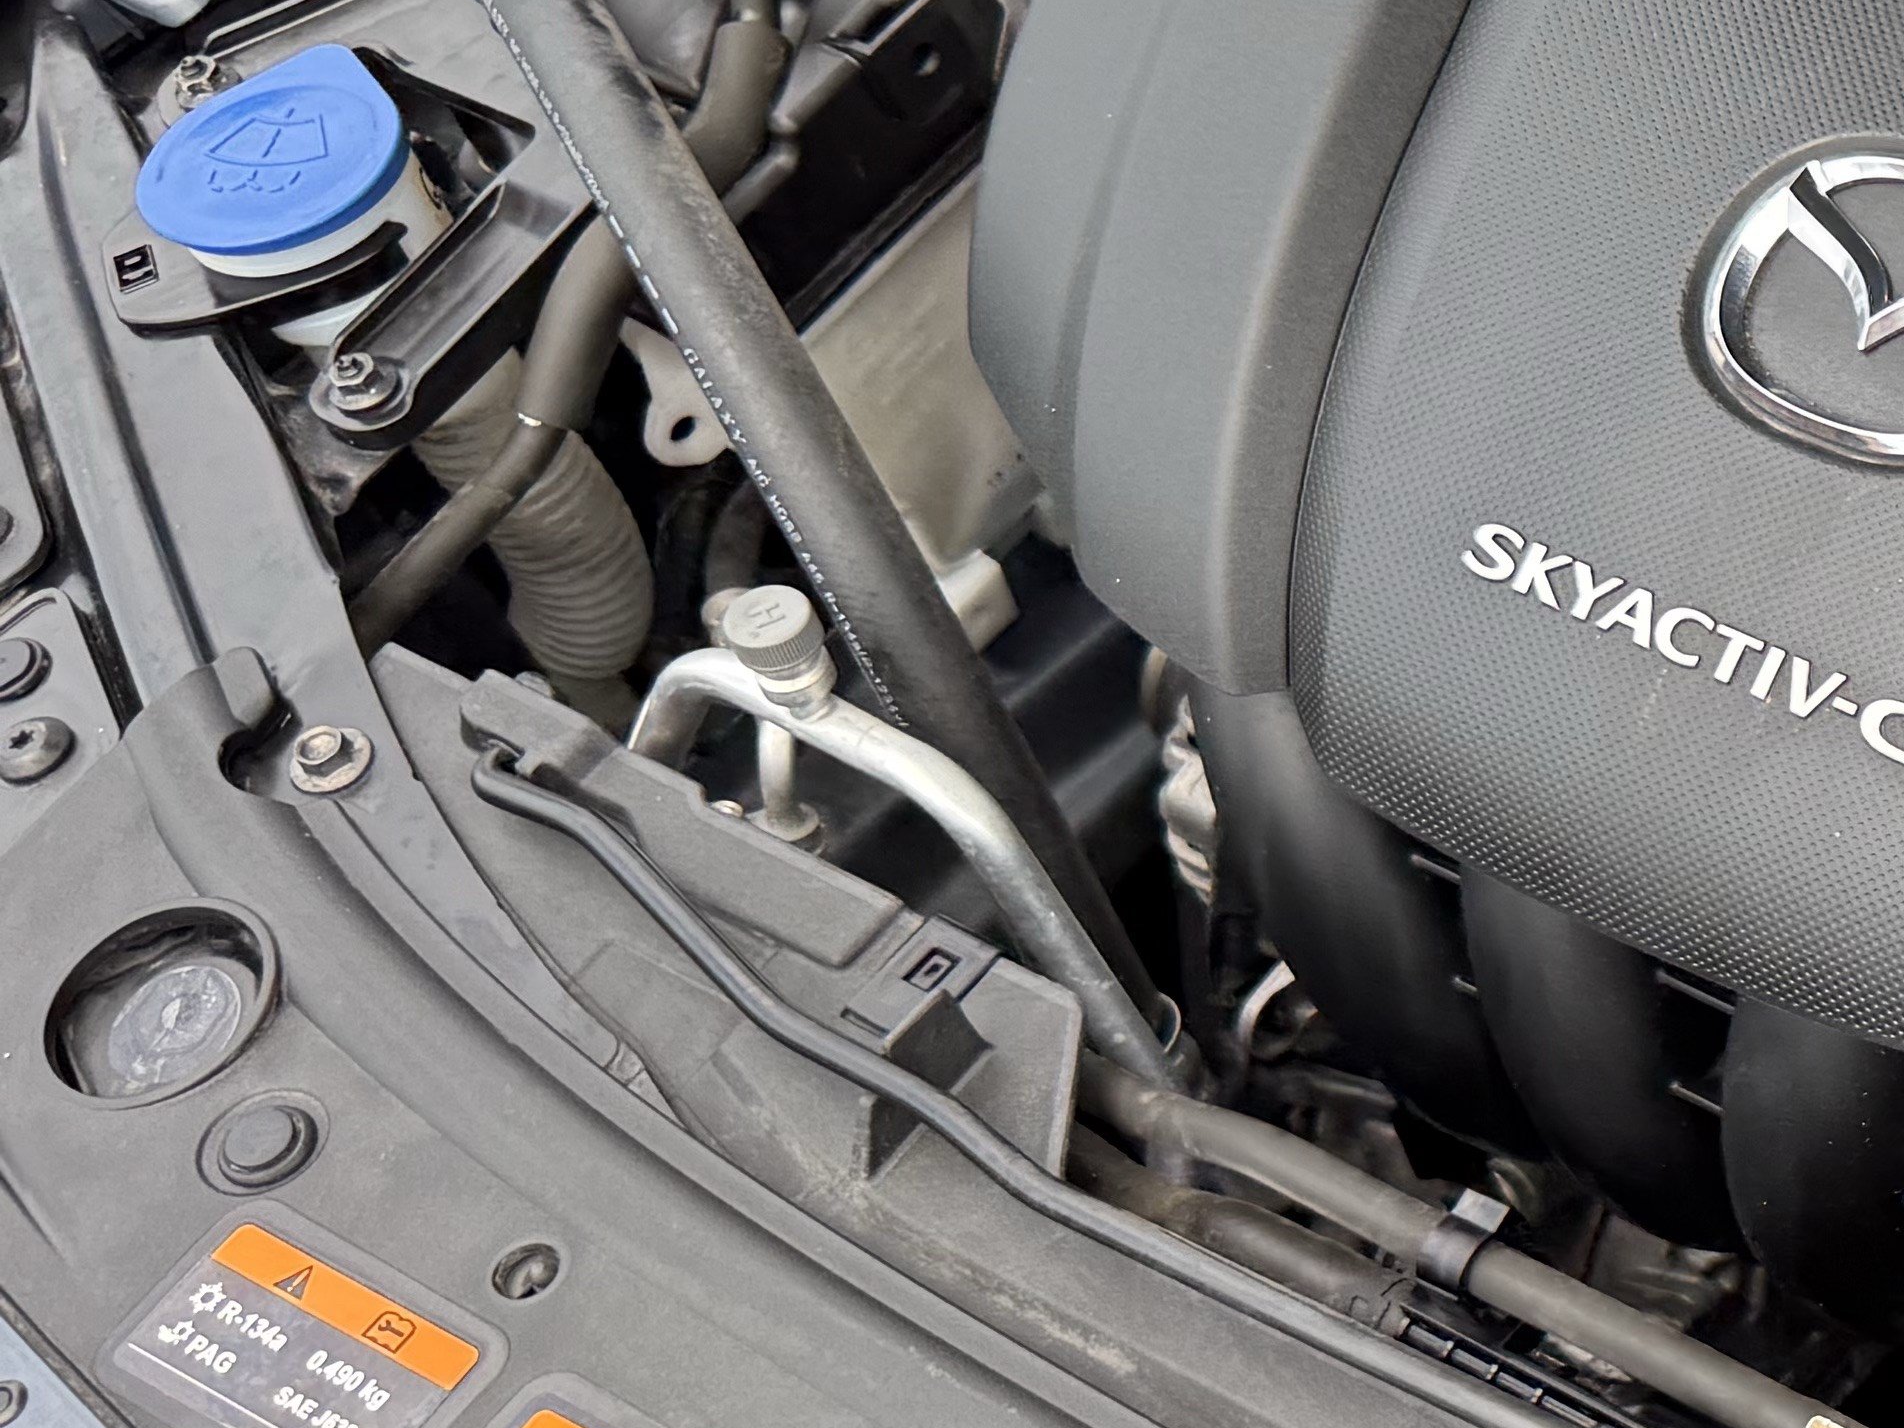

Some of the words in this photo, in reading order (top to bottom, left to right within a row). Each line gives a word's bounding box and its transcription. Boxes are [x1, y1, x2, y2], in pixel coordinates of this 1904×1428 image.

[683, 348, 748, 444] GALAXY
[184, 1334, 237, 1374] PAG
[273, 1386, 319, 1421] SAE
[216, 1299, 288, 1353] R-134a
[305, 1349, 365, 1393] 0.490
[357, 1379, 391, 1412] kg
